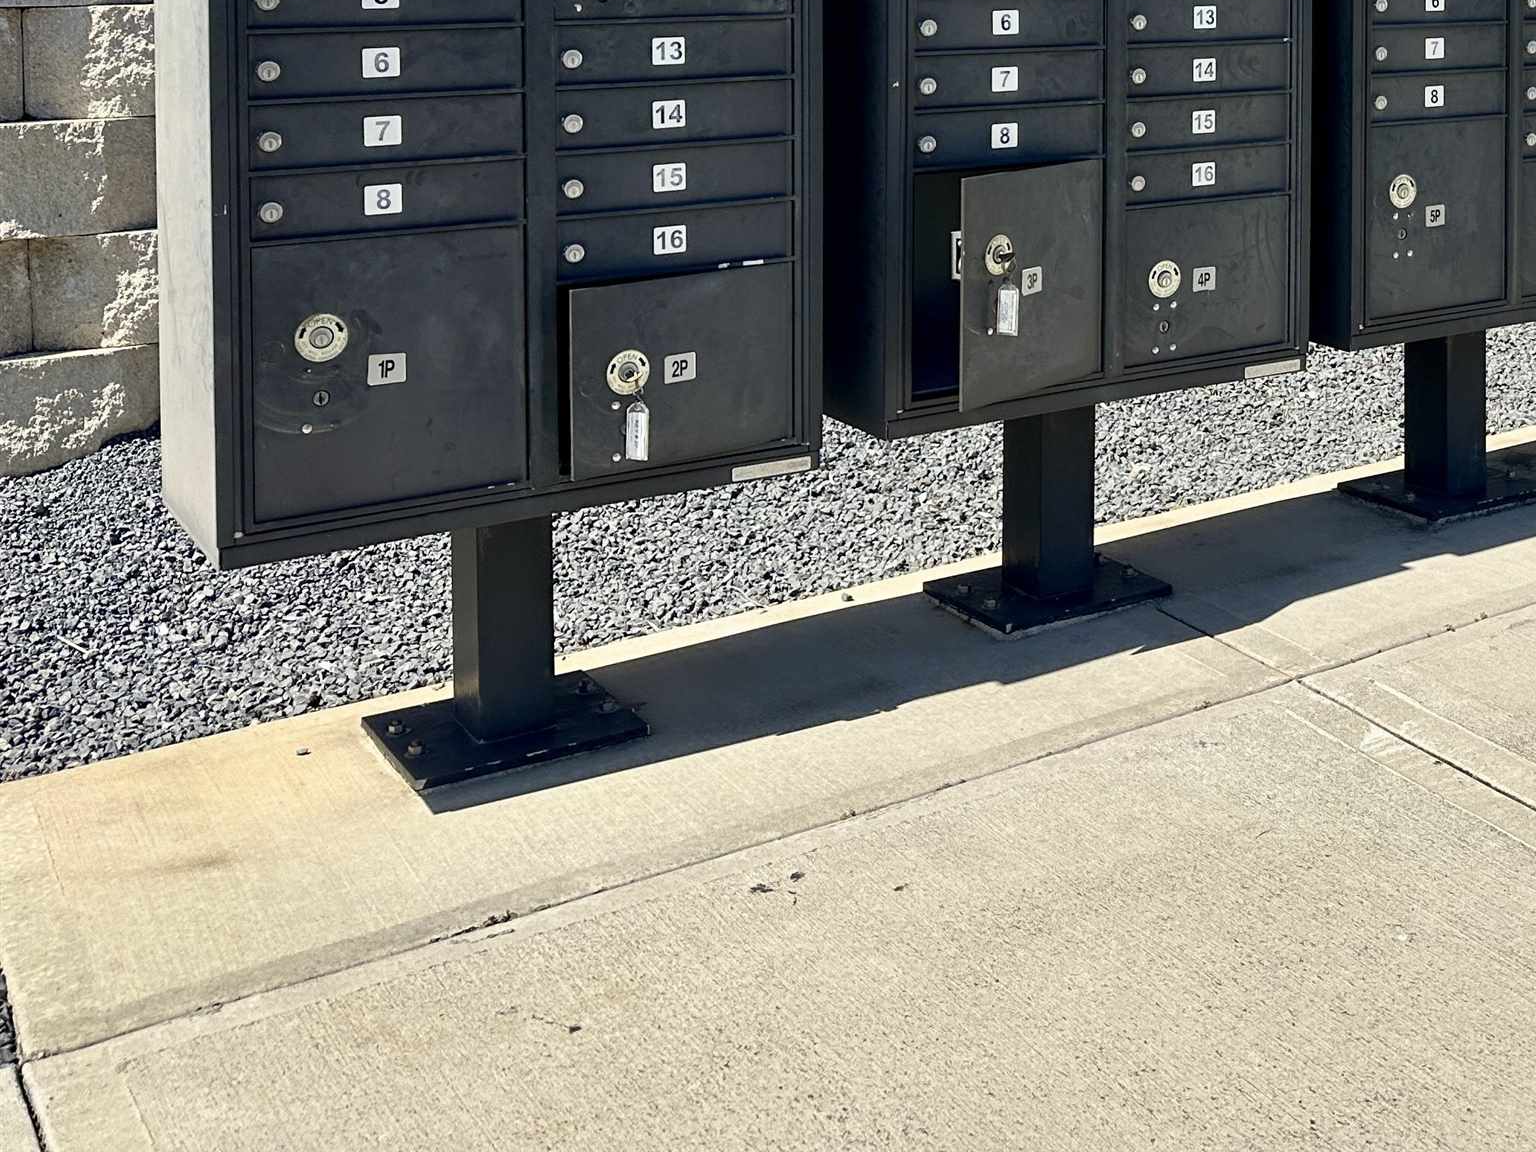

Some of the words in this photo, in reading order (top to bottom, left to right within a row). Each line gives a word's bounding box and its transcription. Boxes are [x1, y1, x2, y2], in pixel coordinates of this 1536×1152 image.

[1000, 13, 1011, 31] 6
[1196, 9, 1215, 25] 13
[655, 41, 683, 61] 13
[1431, 41, 1439, 56] 7
[374, 51, 390, 73] 6
[1195, 61, 1214, 79] 14
[999, 70, 1011, 88] 7
[1430, 89, 1439, 104] 8
[655, 103, 683, 125] 14
[1194, 113, 1214, 131] 15
[375, 120, 391, 142] 7
[999, 127, 1011, 145] 8
[656, 167, 683, 188] 15
[1195, 165, 1214, 183] 16
[376, 189, 392, 210] 8
[1429, 209, 1441, 223] 5P
[656, 229, 684, 251] 16
[1027, 272, 1038, 290] 3P
[1197, 272, 1211, 287] 4P
[616, 352, 638, 364] OPEN
[378, 359, 395, 379] 1P
[671, 359, 689, 378] 2P
